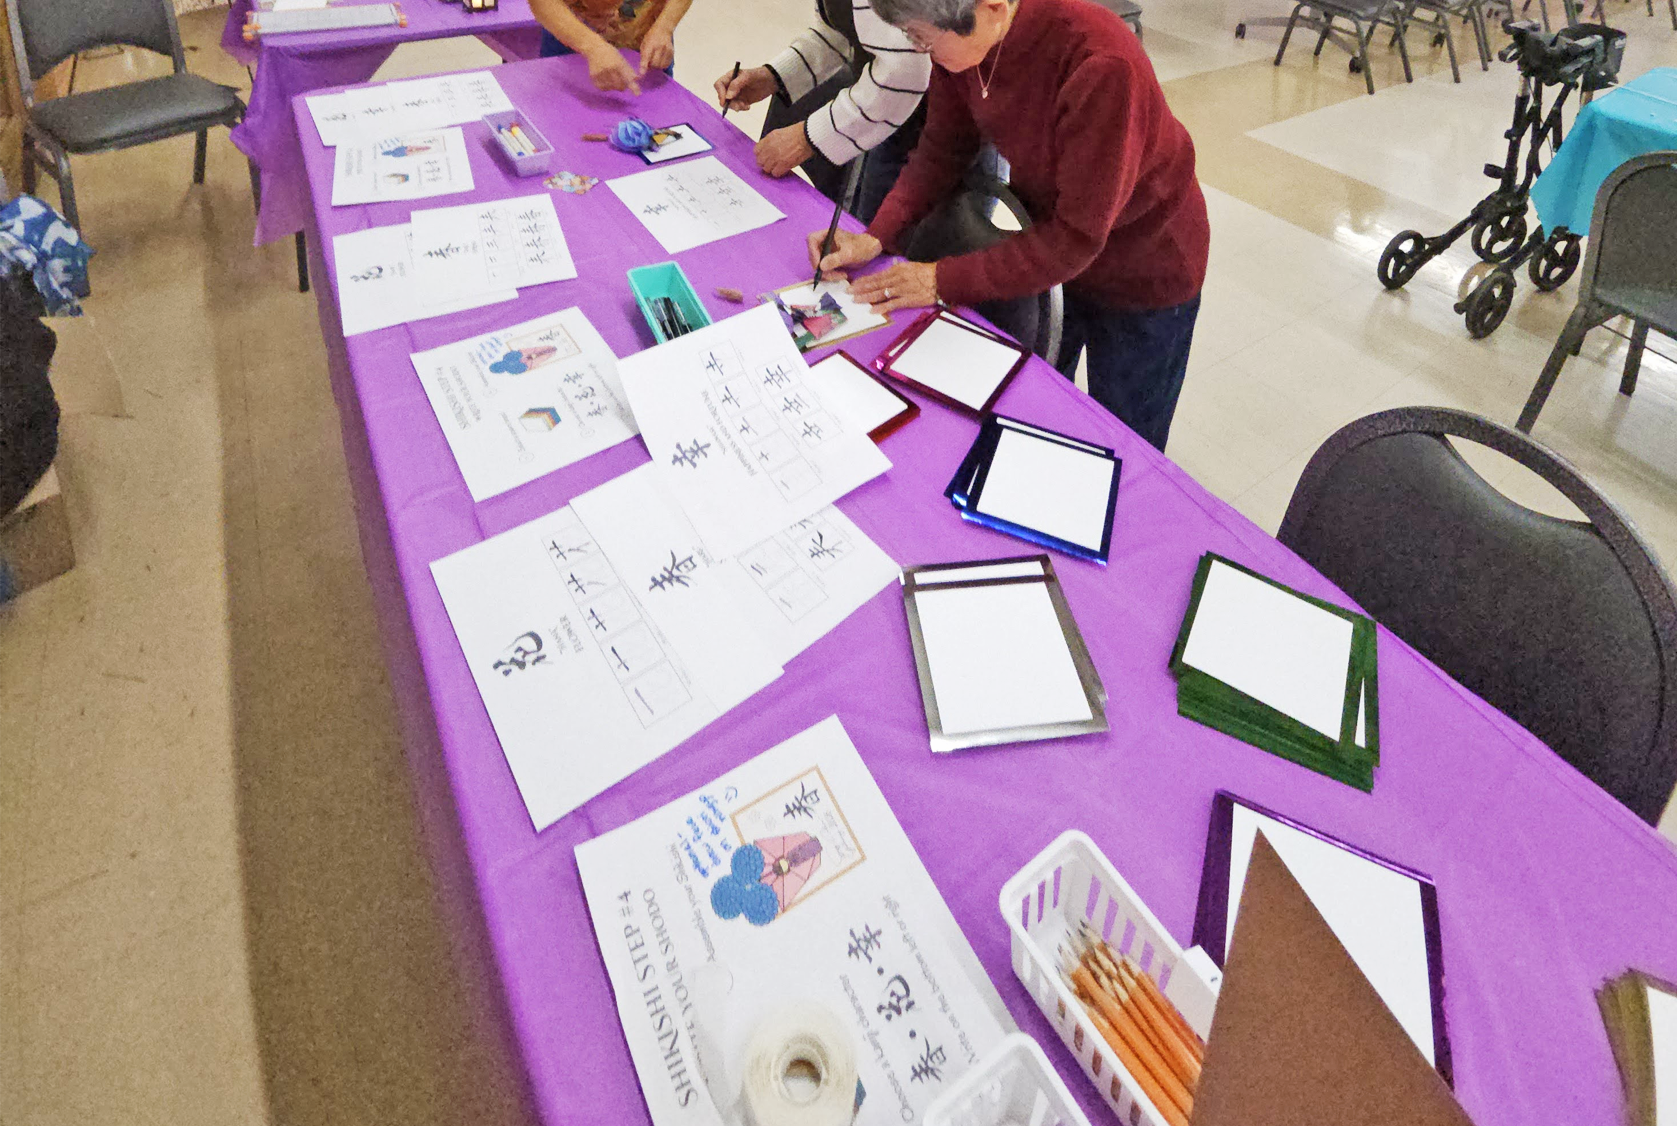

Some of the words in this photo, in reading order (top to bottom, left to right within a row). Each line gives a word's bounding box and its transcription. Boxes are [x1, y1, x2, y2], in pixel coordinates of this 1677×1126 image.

[672, 439, 711, 469] 幸
[649, 550, 697, 591] 春
[493, 631, 547, 677] 花
[771, 782, 820, 819] 春
[670, 843, 689, 884] Shikishi
[684, 885, 698, 908] your
[643, 888, 674, 956] SHODO
[692, 909, 716, 963] Assemble
[897, 919, 907, 931] or
[624, 925, 655, 983] STEP
[915, 952, 940, 994] bottom
[666, 956, 693, 1017] YOUR
[839, 975, 870, 1029] character
[643, 985, 698, 1108] SHIKISHI
[886, 1070, 914, 1124] Choose
